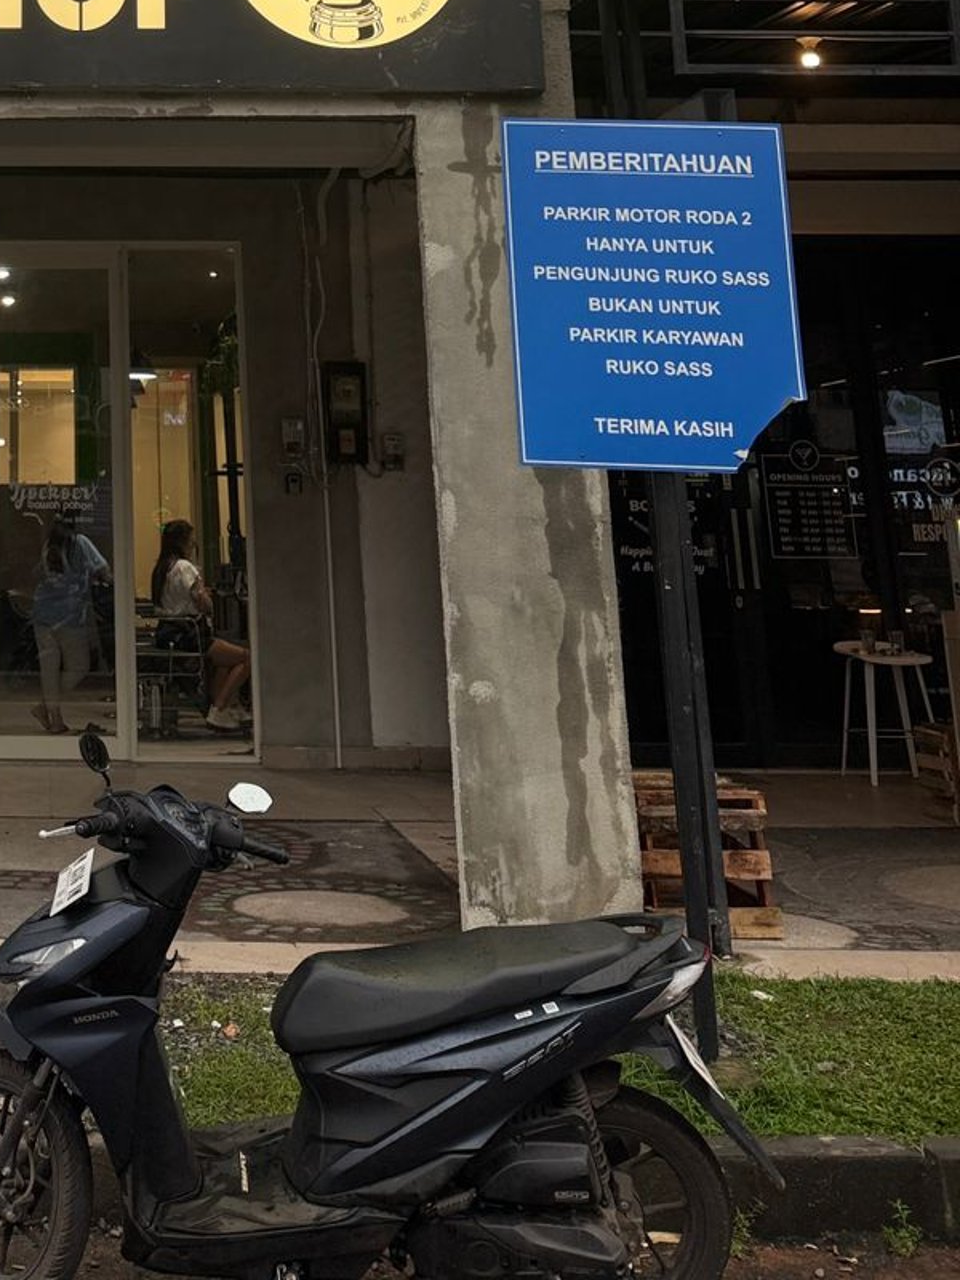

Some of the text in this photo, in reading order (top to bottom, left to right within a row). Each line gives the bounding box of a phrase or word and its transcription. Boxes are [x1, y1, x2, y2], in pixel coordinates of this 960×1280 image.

[535, 151, 753, 174] PEMBERITAHUAN
[543, 206, 753, 226] PARKIR MOTOR RODA 2
[586, 237, 715, 255] HANYA UNTUK
[533, 266, 771, 287] PENGUNJUNG RUKO SASS
[588, 297, 722, 316] BUKAN UNTUK
[569, 327, 745, 347] PARKIR KARYAWAN
[605, 359, 714, 377] RUKO SASS
[594, 417, 735, 438] TERIMA KASIH
[72, 1009, 119, 1025] HONDA
